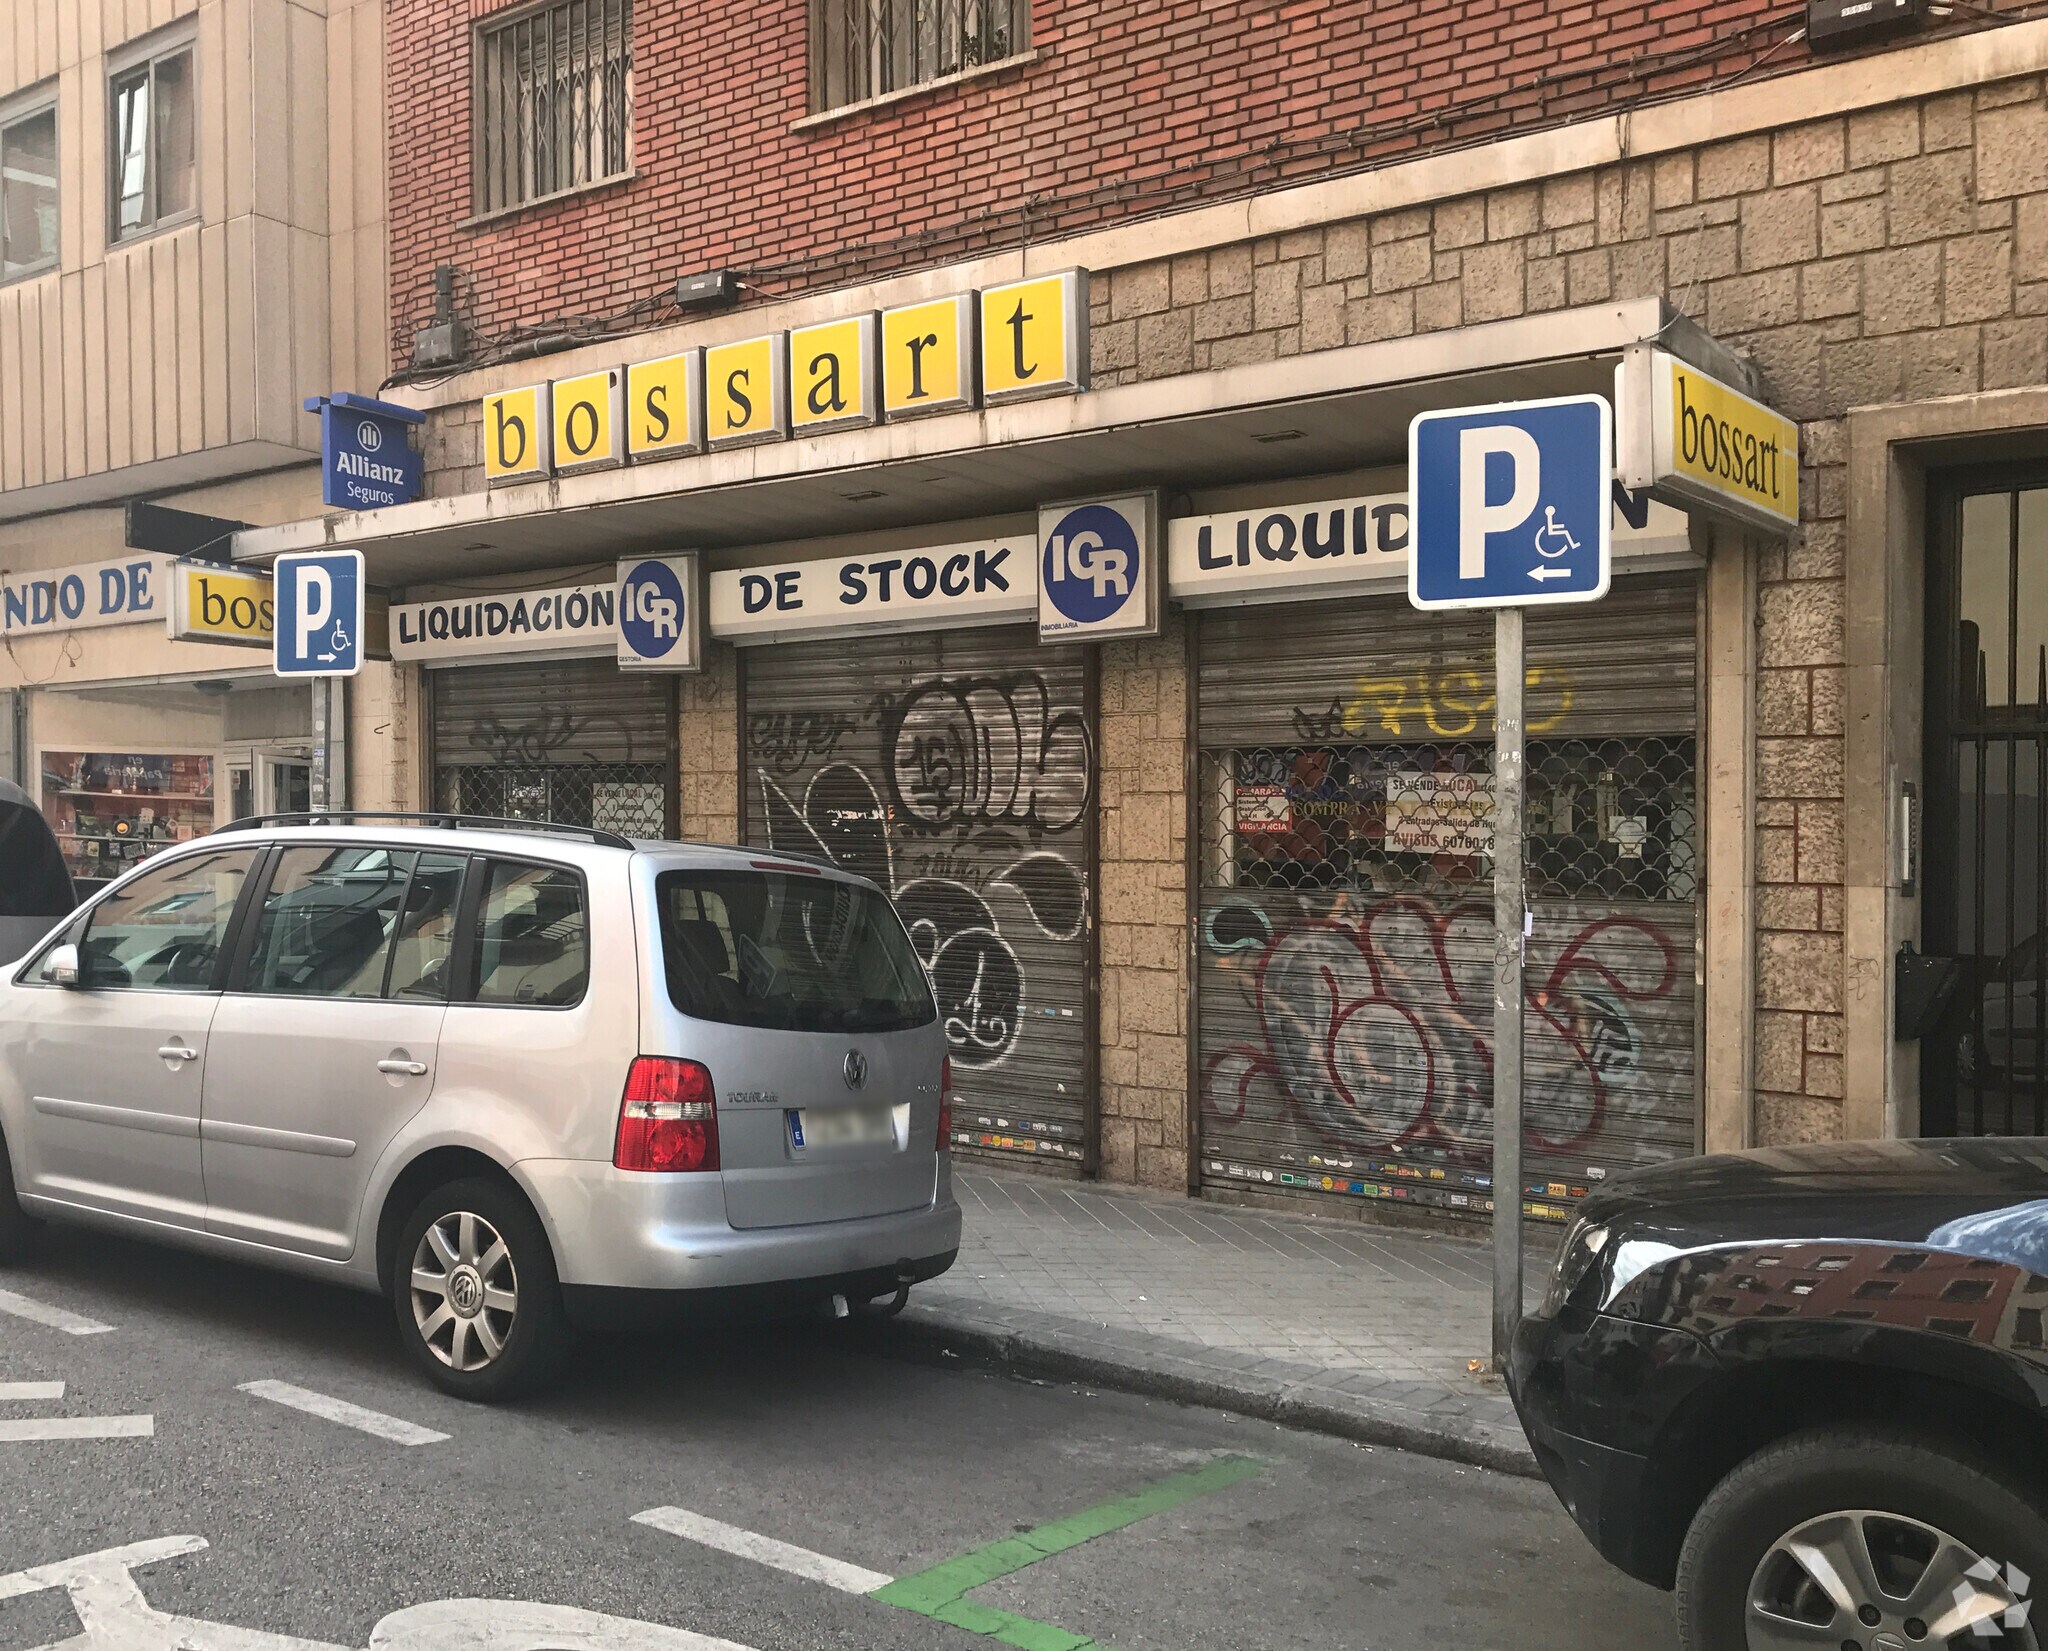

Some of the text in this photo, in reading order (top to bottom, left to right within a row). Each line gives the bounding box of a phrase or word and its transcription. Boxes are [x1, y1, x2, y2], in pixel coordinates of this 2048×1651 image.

[493, 297, 1039, 469] bossart
[336, 451, 404, 485] Allianz
[1678, 376, 1779, 499] bossart
[347, 481, 394, 504] Seguros
[1198, 478, 1648, 570] LIQUIDN
[1460, 425, 1540, 579] P
[0, 561, 154, 629] NDO DE
[739, 548, 1011, 614] DE STOCK
[1053, 530, 1128, 598] IGR
[198, 577, 274, 633] bos
[296, 565, 332, 659] P
[400, 587, 614, 644] LIQUIDACIÓN
[626, 581, 678, 638] IGR
[1041, 622, 1078, 631] INMOBILIARIA
[1239, 822, 1287, 831] VIGILANCIA
